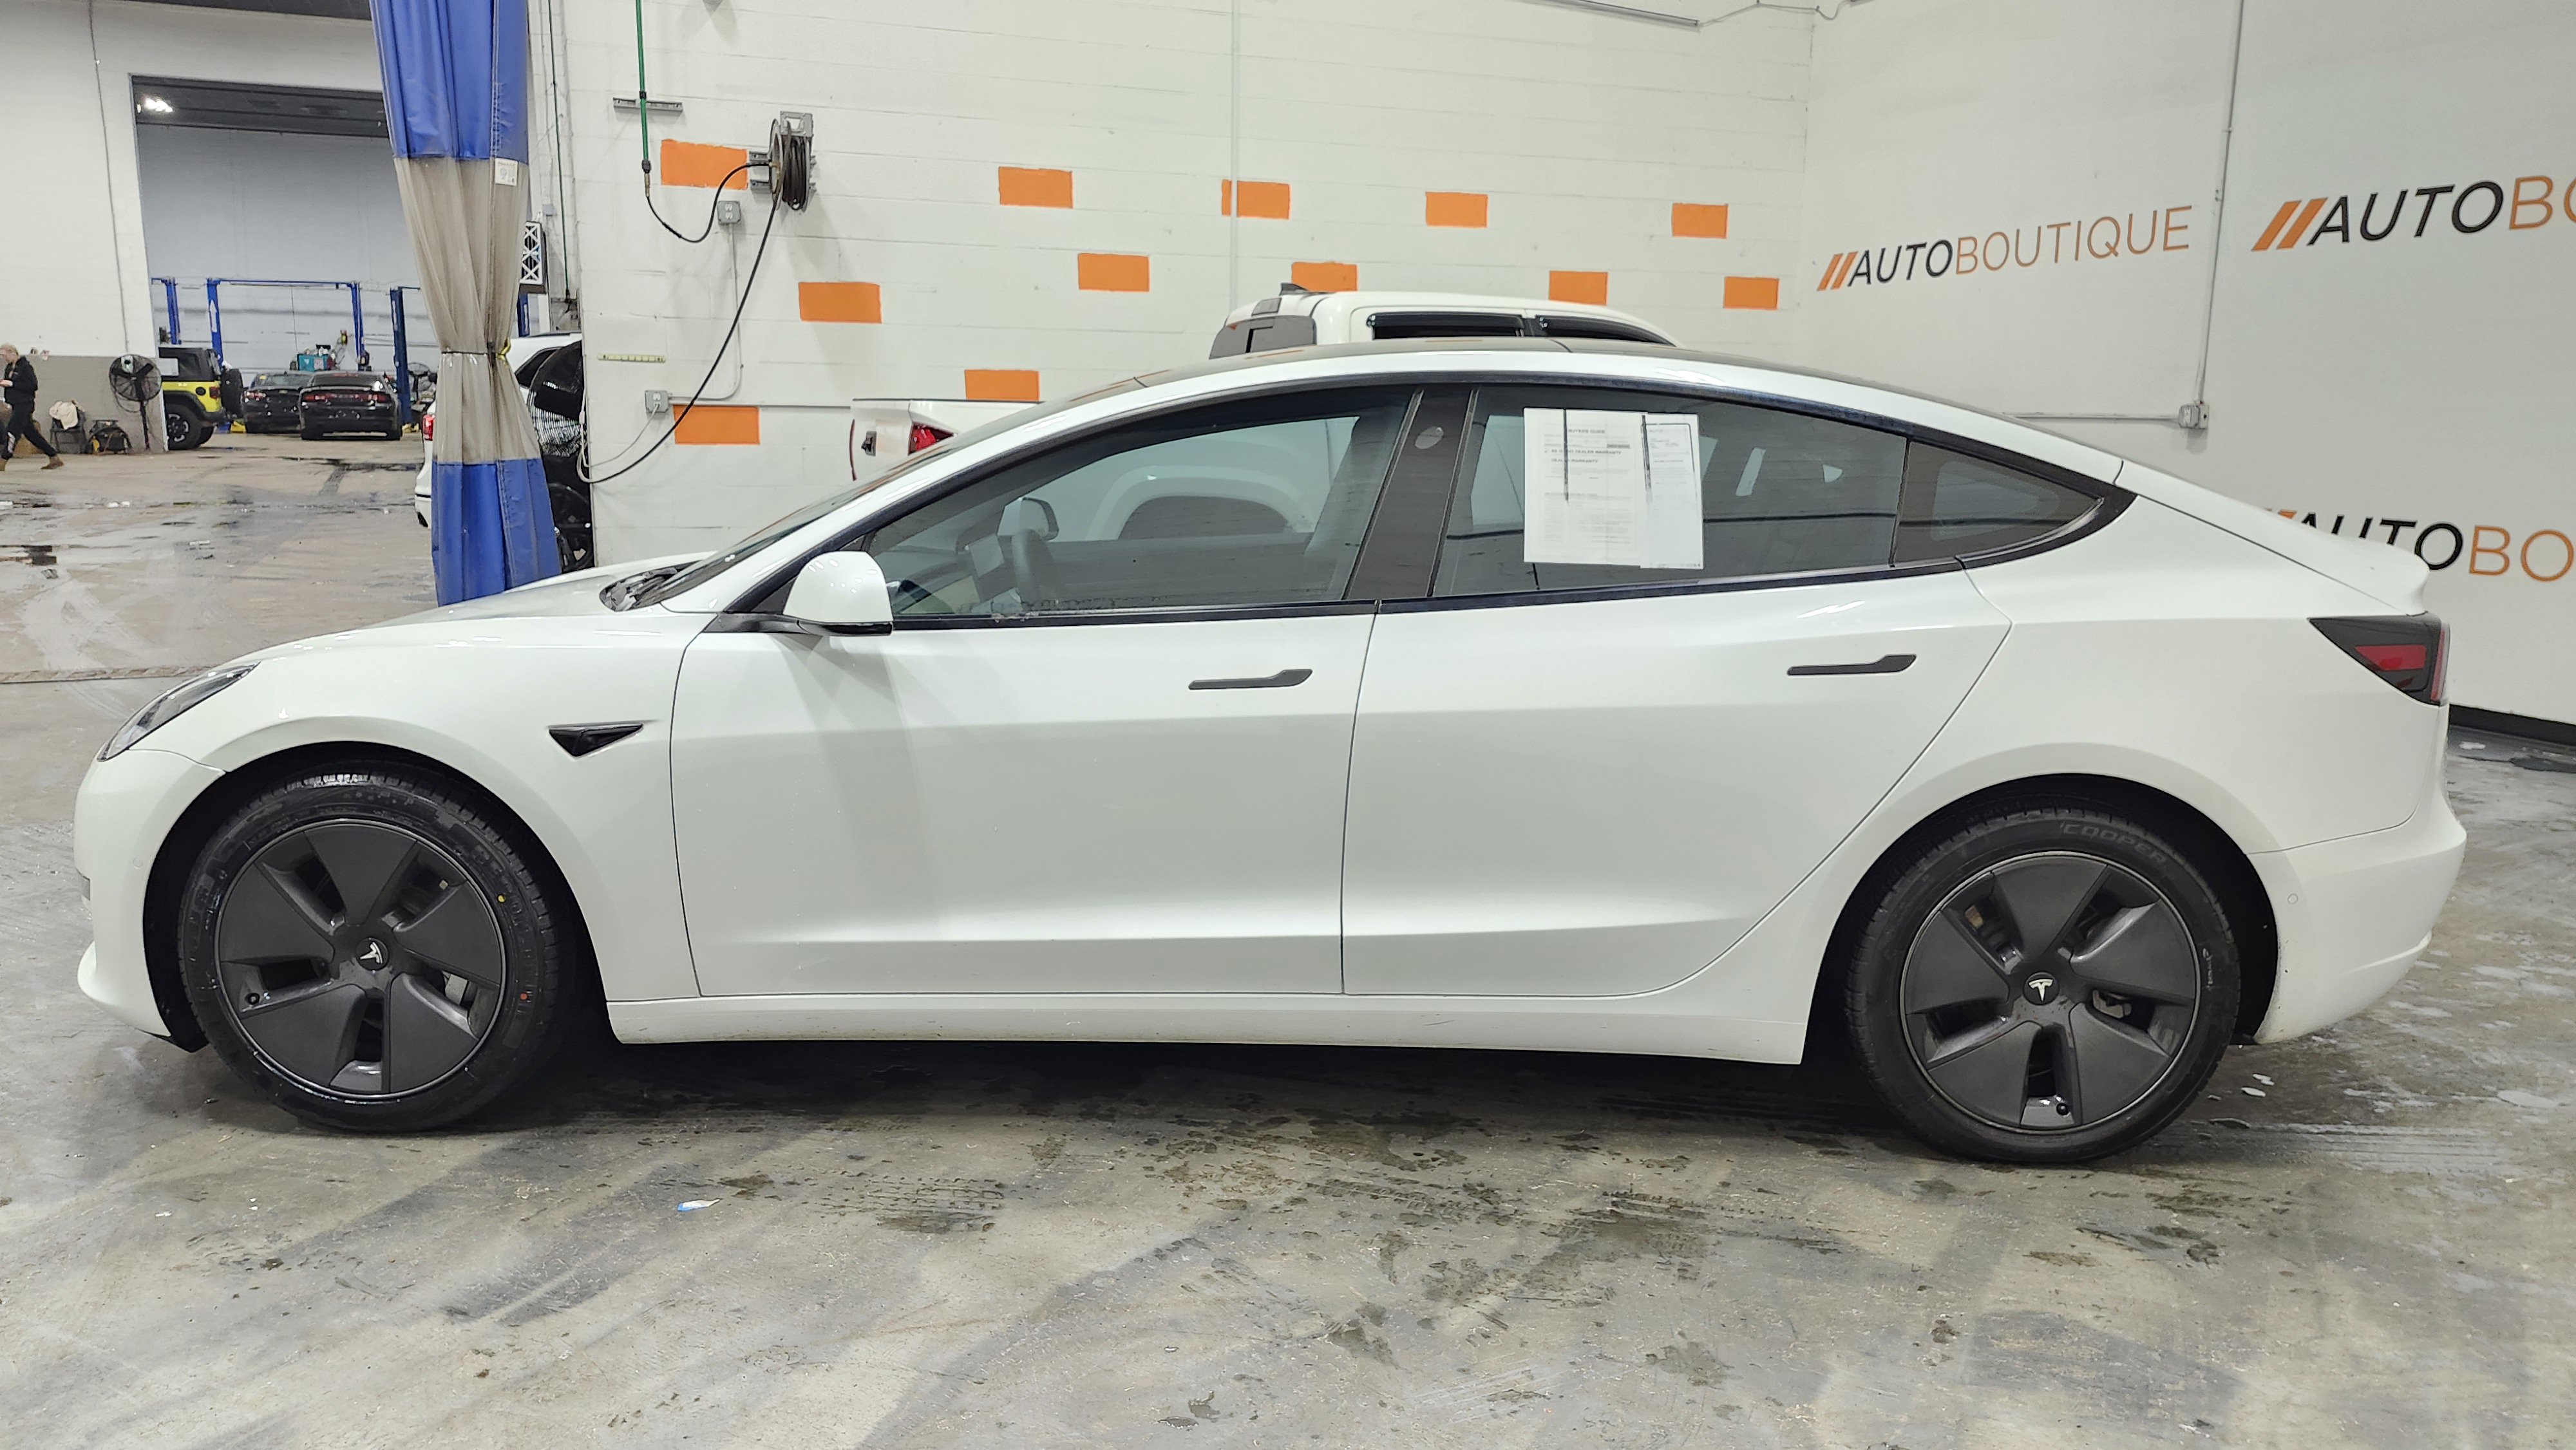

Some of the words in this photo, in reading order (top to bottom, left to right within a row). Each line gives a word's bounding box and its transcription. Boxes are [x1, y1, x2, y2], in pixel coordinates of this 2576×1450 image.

[1847, 205, 2192, 287] AUTOBOUTIQUE
[2306, 175, 2576, 247] AUTOB
[2062, 824, 2166, 863] COOPER
